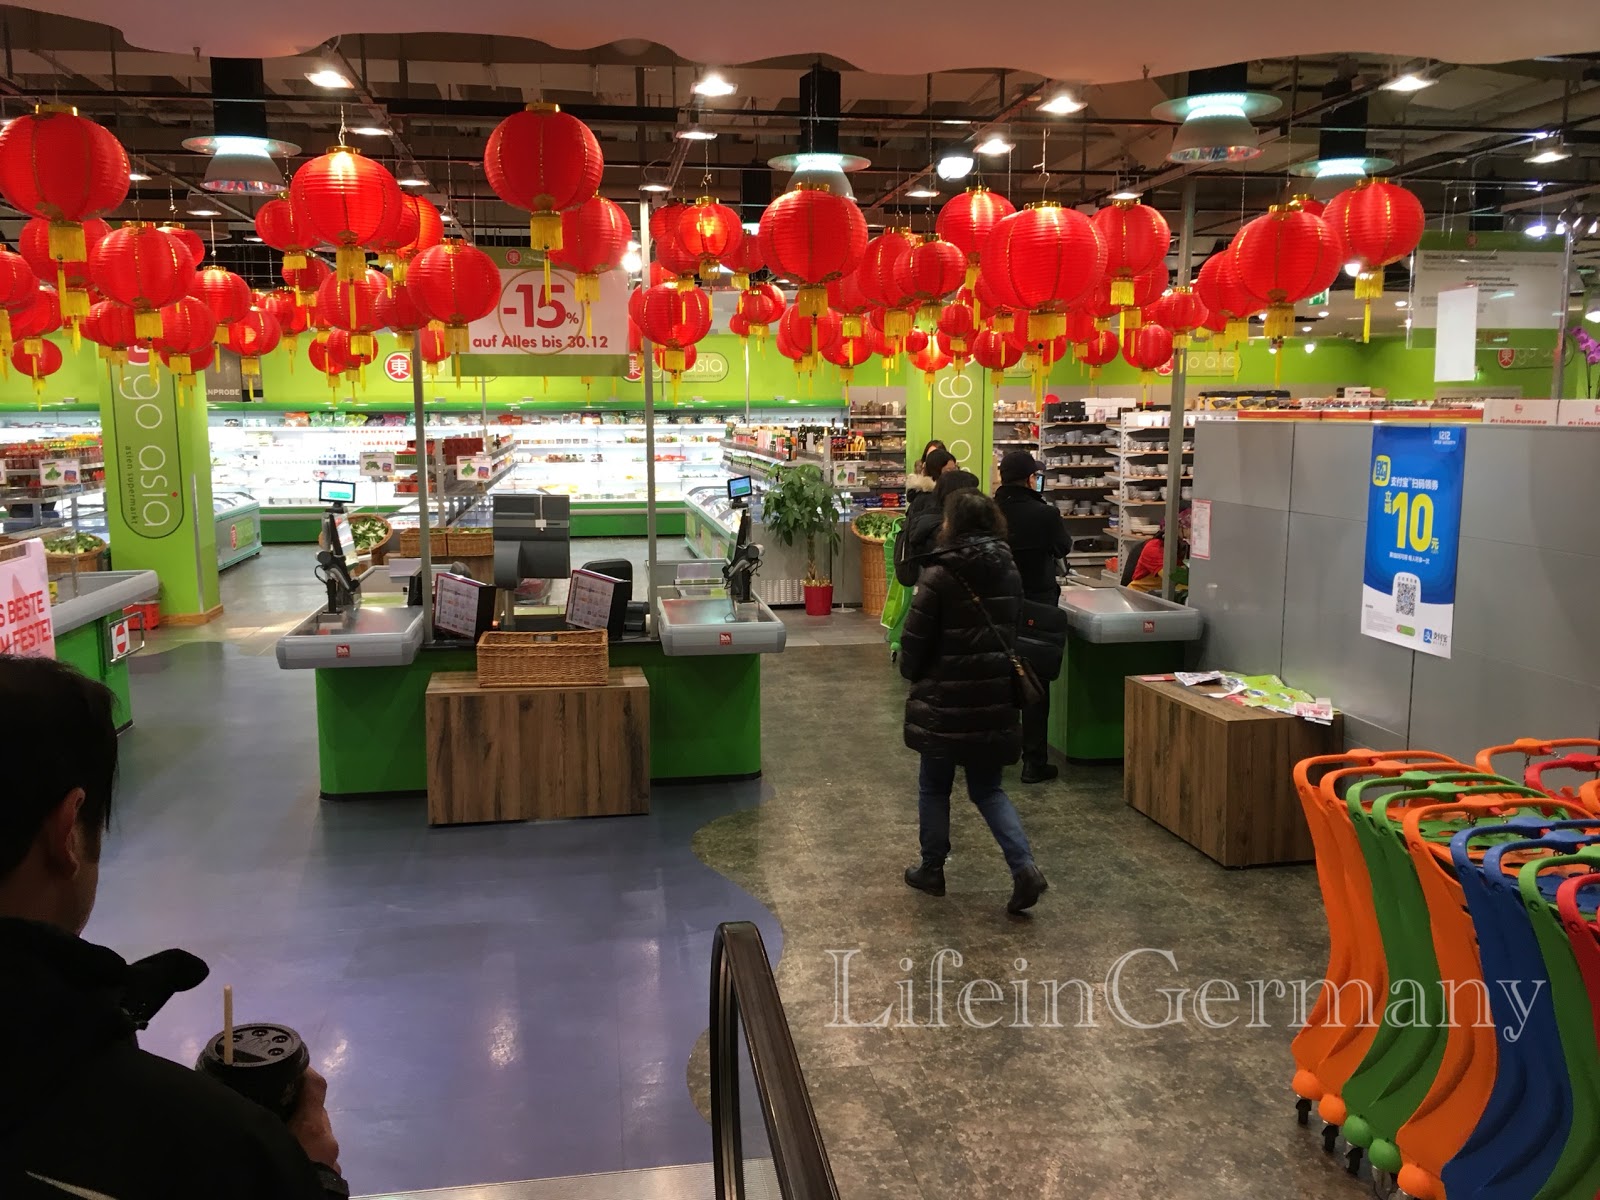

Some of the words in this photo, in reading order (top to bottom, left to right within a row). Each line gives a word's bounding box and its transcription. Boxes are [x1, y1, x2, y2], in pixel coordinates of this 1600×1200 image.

[473, 335, 498, 348] auf
[502, 335, 537, 348] Alles
[542, 335, 562, 348] bis
[567, 335, 608, 348] 30.12
[389, 358, 409, 376] 東
[125, 445, 133, 470] asien
[127, 473, 138, 525] supermarkt
[138, 445, 180, 527] asia
[1392, 491, 1434, 552] 10
[7, 590, 45, 624] BESTE
[12, 618, 52, 655] FESTE!
